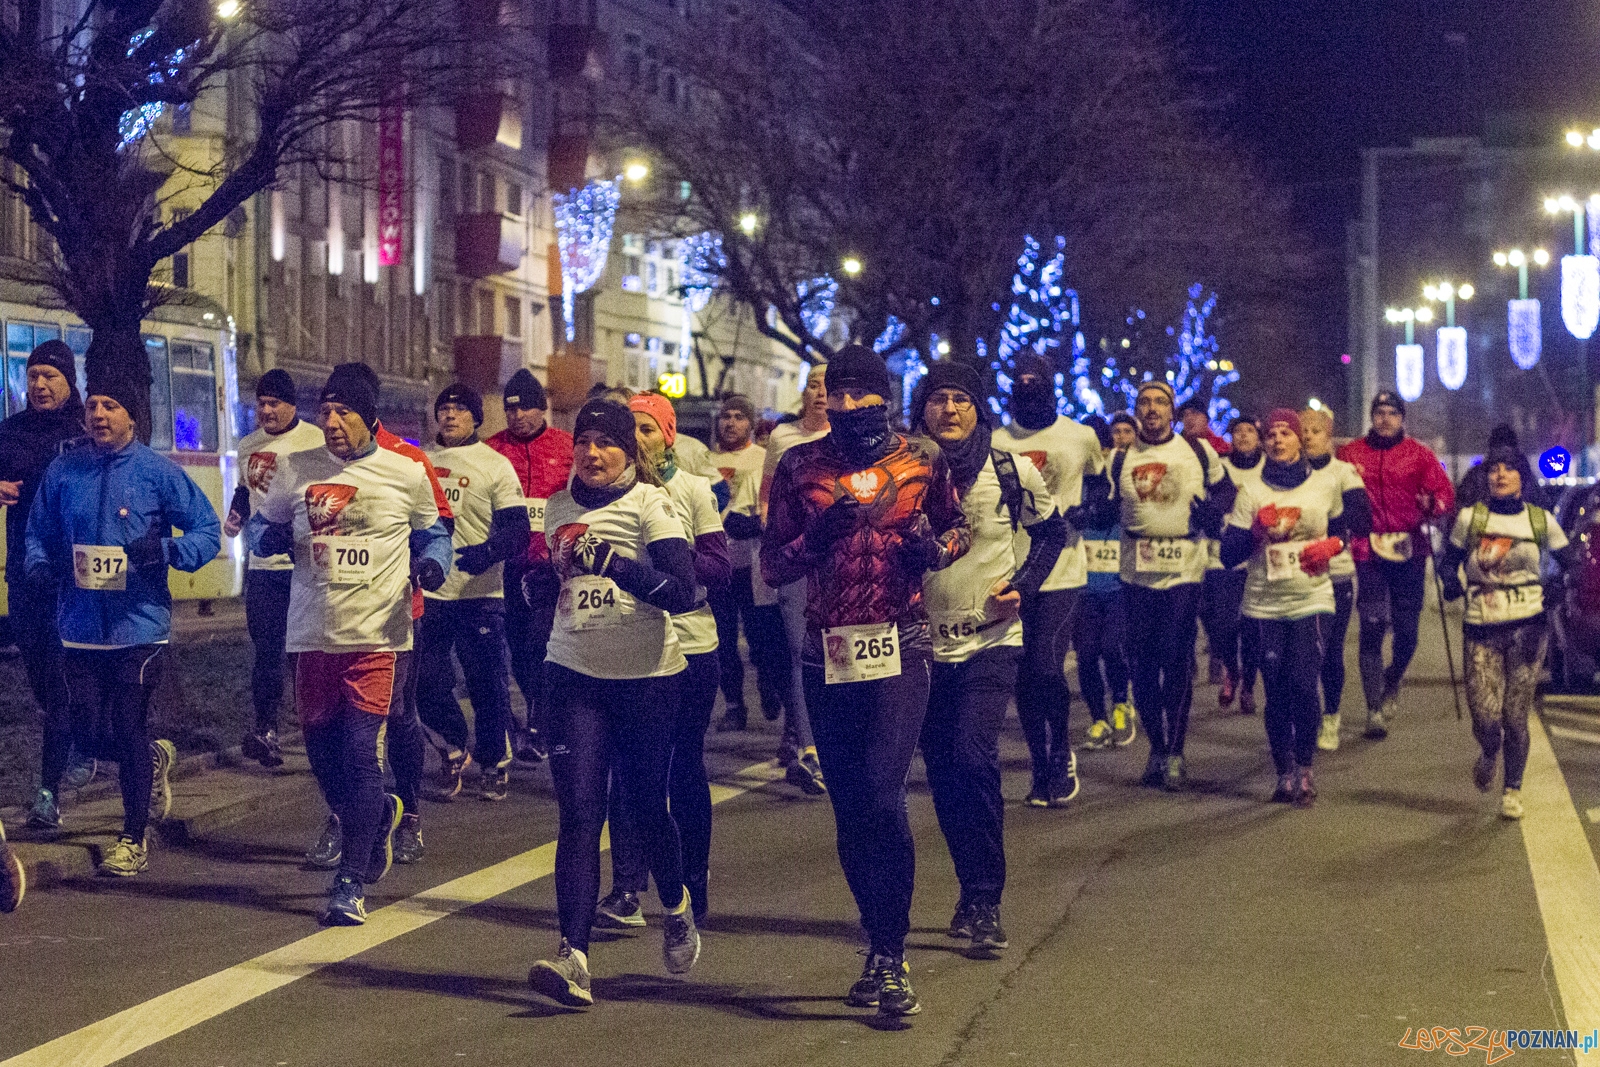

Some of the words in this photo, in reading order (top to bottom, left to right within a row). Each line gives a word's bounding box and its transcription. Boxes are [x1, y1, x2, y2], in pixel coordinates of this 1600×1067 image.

[658, 372, 687, 398] 20
[336, 548, 370, 566] 700
[1158, 547, 1182, 559] 426
[92, 557, 123, 574] 317
[577, 588, 616, 610] 264
[938, 622, 975, 639] 615
[854, 637, 895, 660] 265
